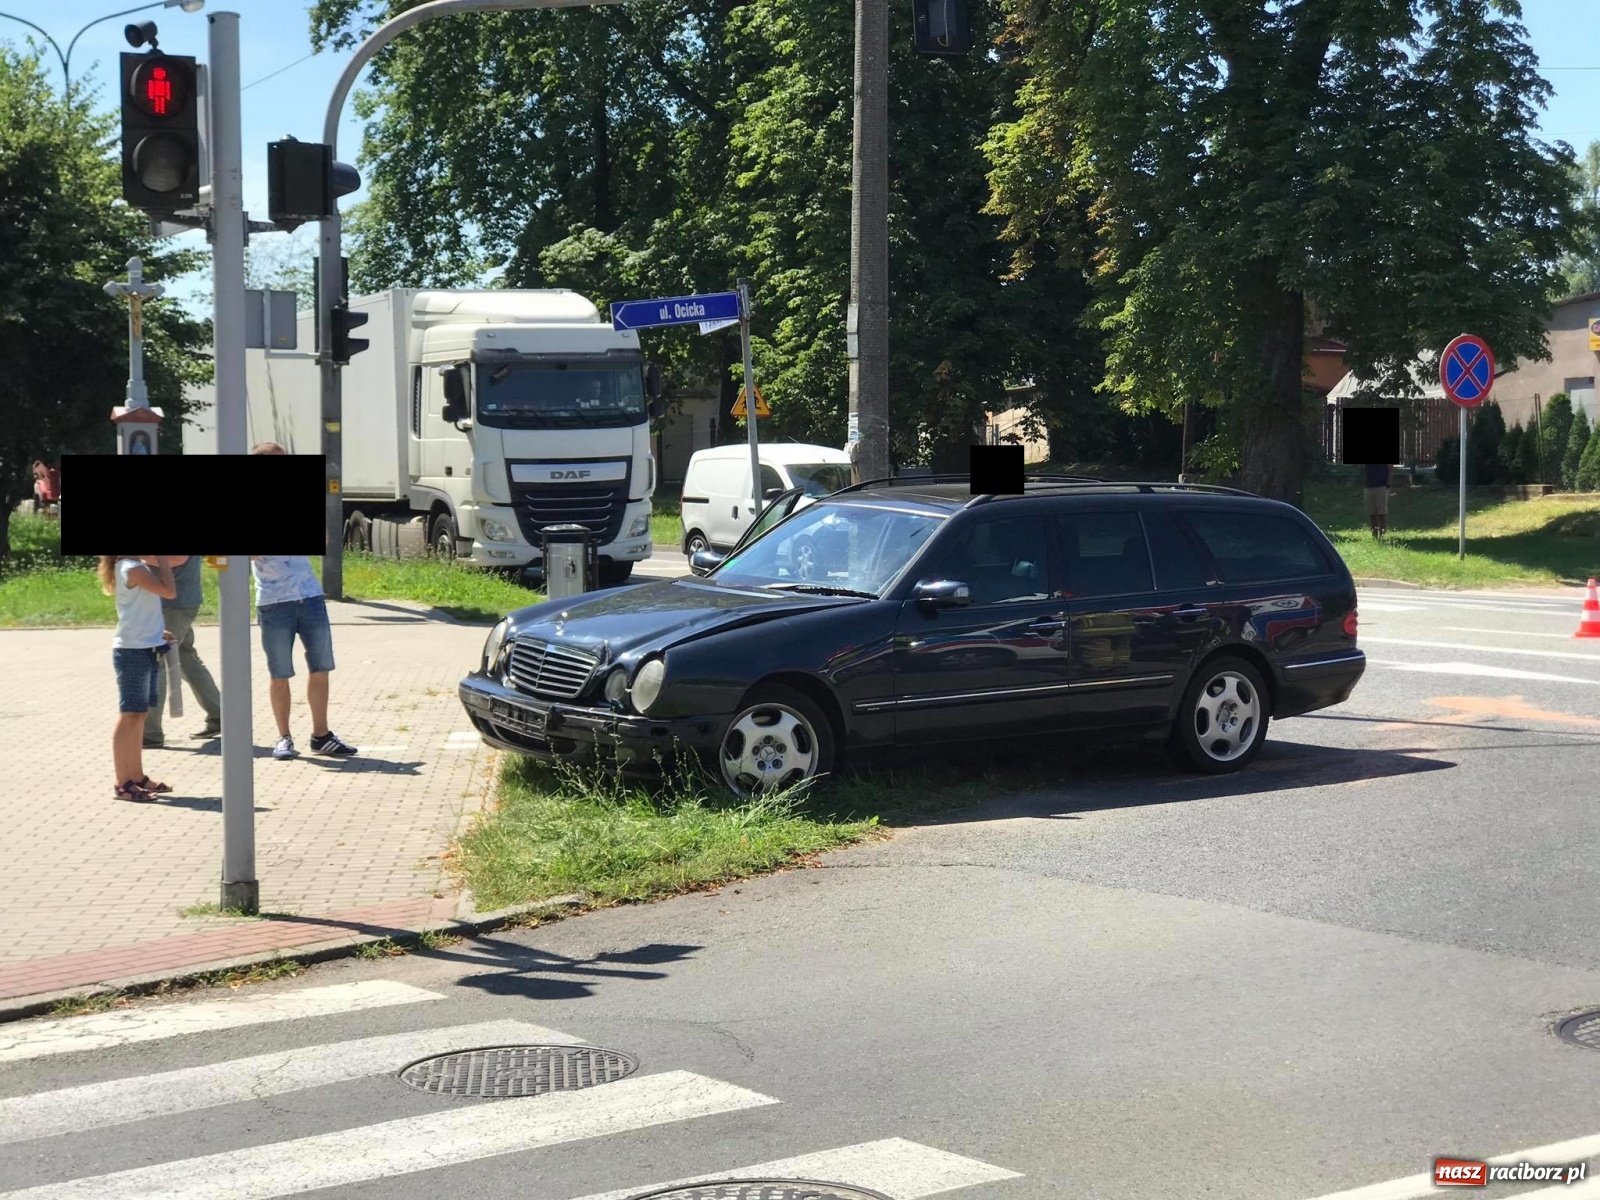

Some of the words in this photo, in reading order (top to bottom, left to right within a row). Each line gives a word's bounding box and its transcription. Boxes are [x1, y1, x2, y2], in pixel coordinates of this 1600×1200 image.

[659, 305, 671, 320] ul.
[674, 302, 705, 318] Ocicka
[550, 470, 591, 479] DAF
